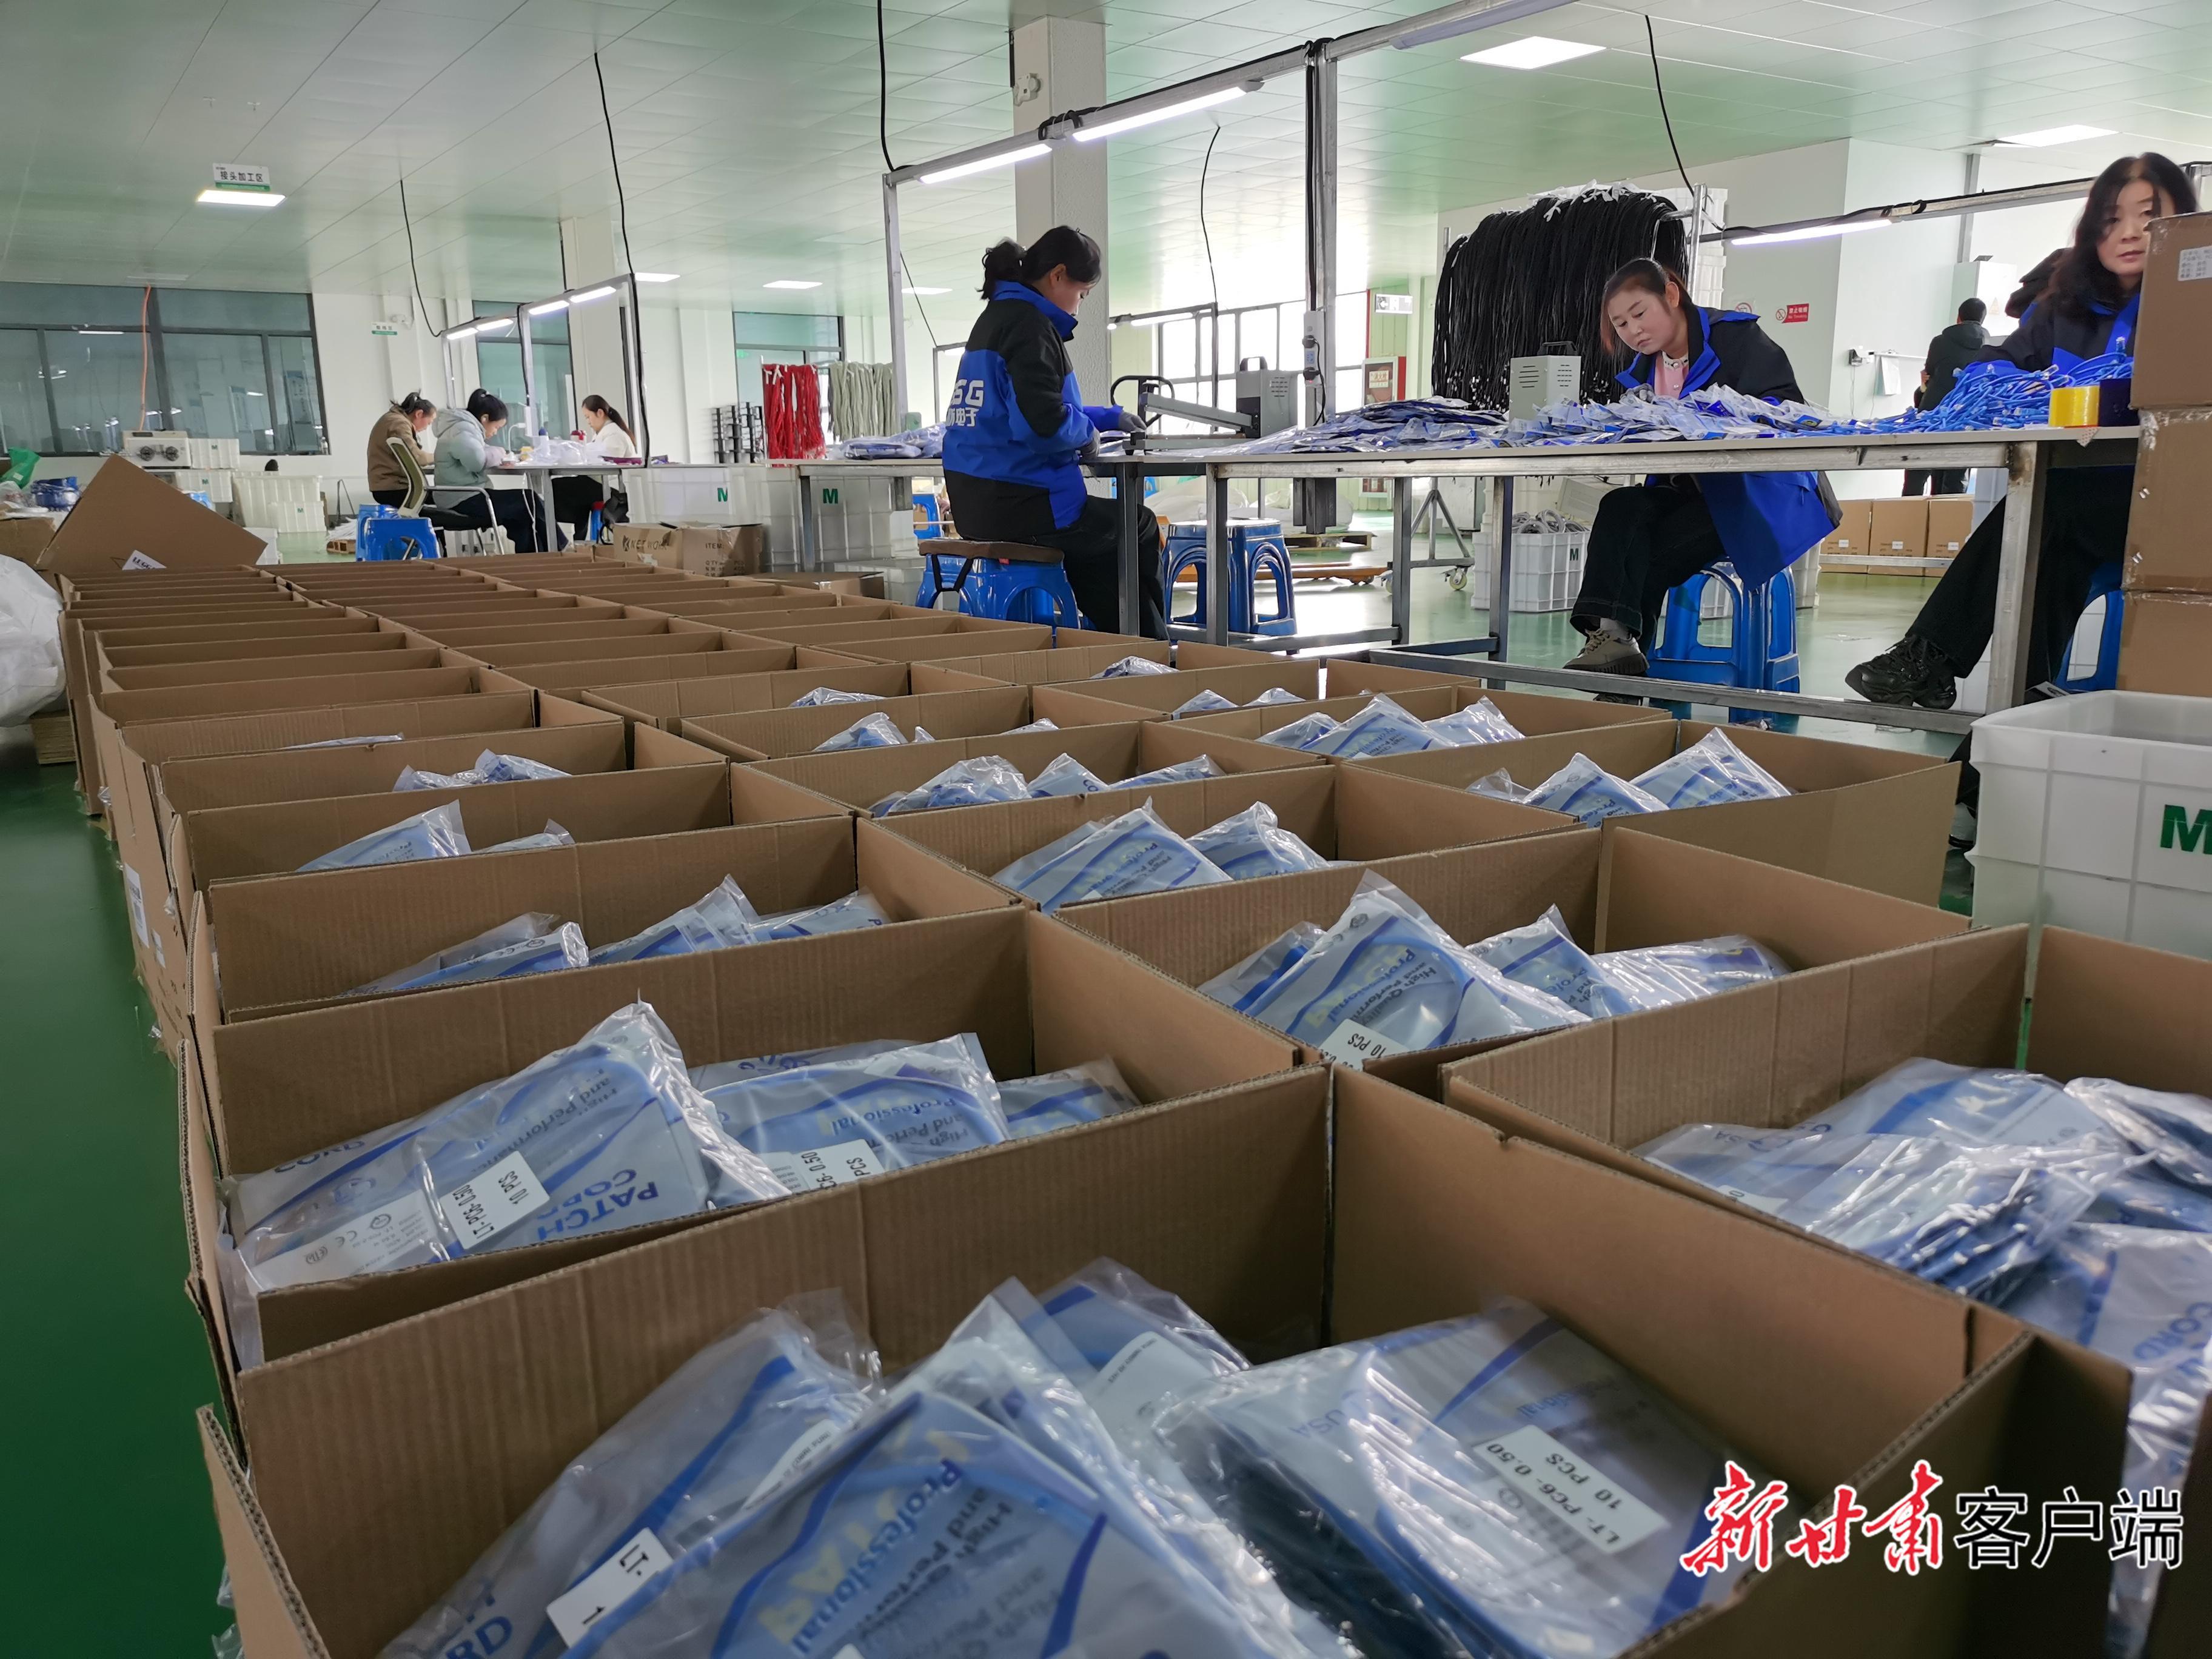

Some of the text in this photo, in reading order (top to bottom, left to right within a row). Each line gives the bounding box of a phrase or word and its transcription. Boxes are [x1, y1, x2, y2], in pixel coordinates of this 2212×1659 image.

[220, 171, 263, 182] 接头加工区
[823, 488, 838, 504] M
[2160, 804, 2212, 855] M
[1347, 1033, 1387, 1059] 10 PCS
[846, 1156, 871, 1178] PCS
[498, 1170, 529, 1205] 10 PCS
[538, 1182, 659, 1241] PATCH
[1545, 1453, 1623, 1509] 10 PCS
[793, 1458, 963, 1654] Professional
